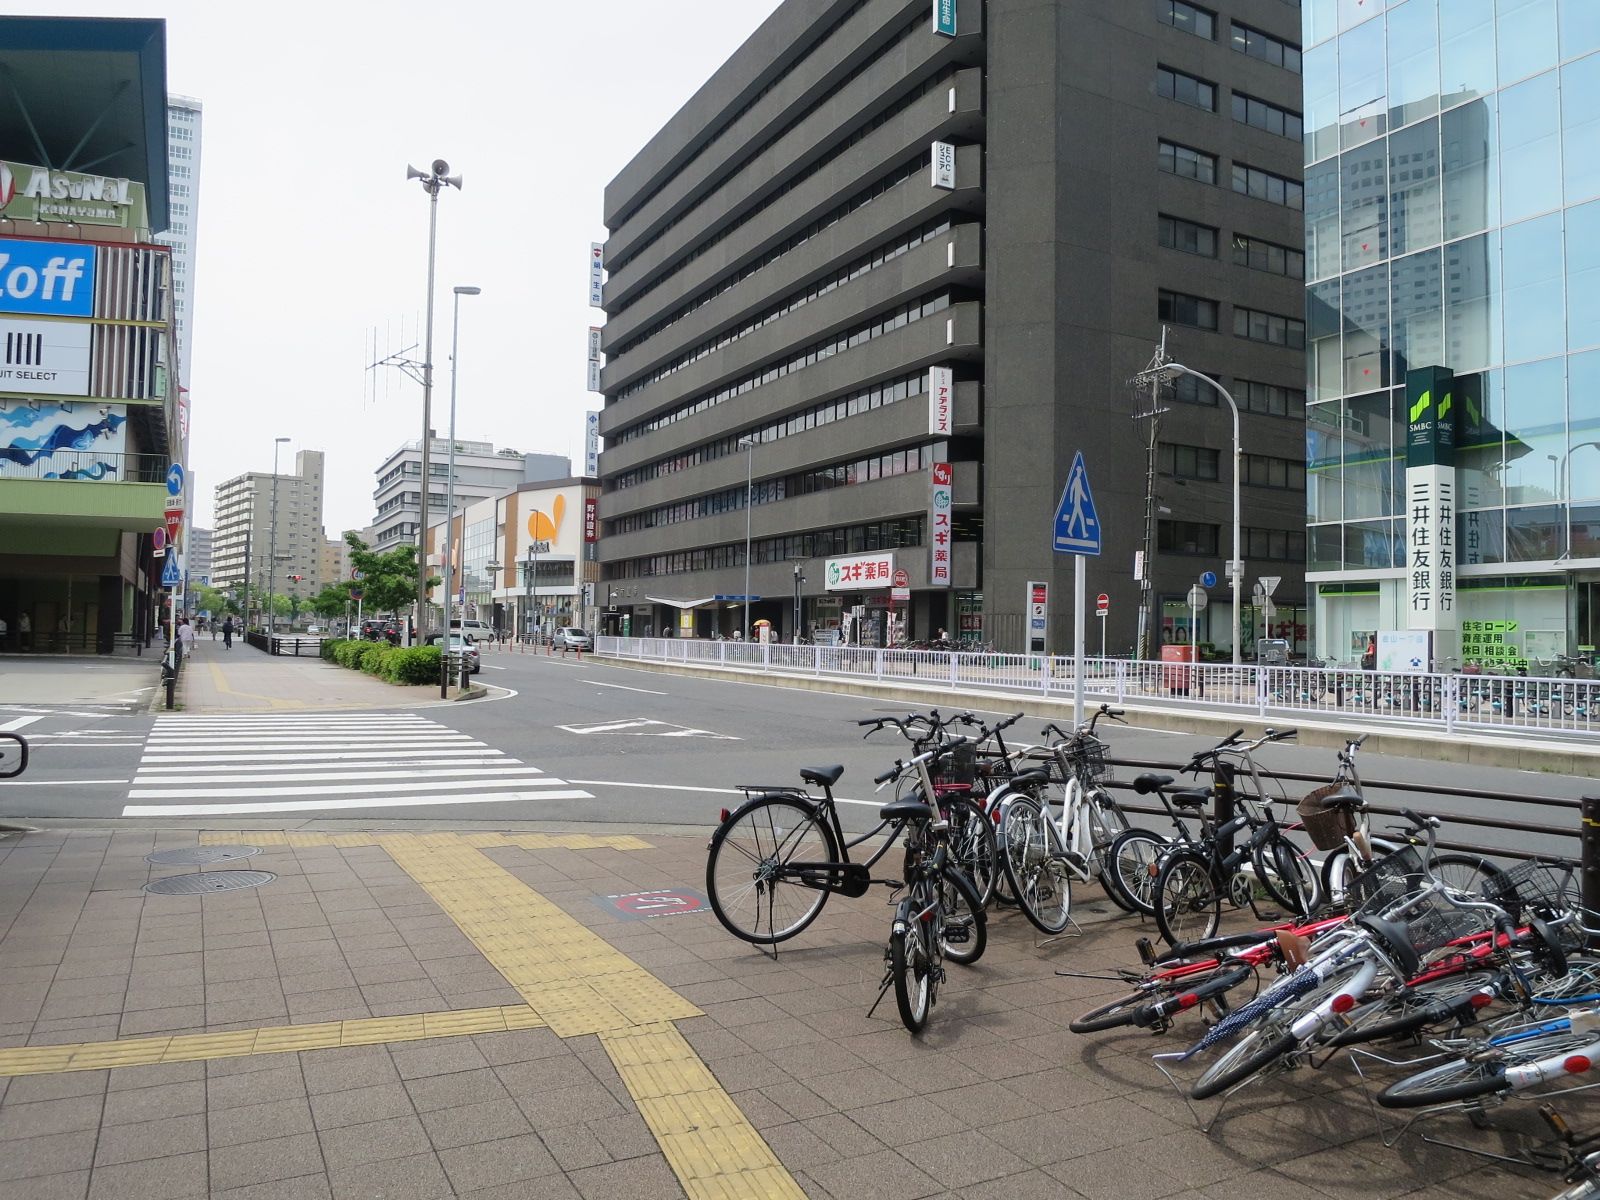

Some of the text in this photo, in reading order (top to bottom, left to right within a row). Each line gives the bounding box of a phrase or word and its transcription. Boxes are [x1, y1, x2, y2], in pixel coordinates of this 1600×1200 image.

[16, 371, 57, 381] SELECT
[938, 387, 948, 431] アデランス
[1409, 421, 1432, 432] SMBC
[1437, 421, 1453, 431] SMBC
[934, 463, 951, 485] くすり
[935, 514, 950, 579] スギ薬局
[1412, 483, 1431, 611] 三井住友銀行
[1439, 483, 1452, 611] 三井住友銀行
[841, 561, 889, 581] スギ薬局
[1462, 621, 1517, 631] 住宅ローン
[1462, 633, 1503, 644] 資産運用
[1462, 645, 1517, 656] 休日相談会
